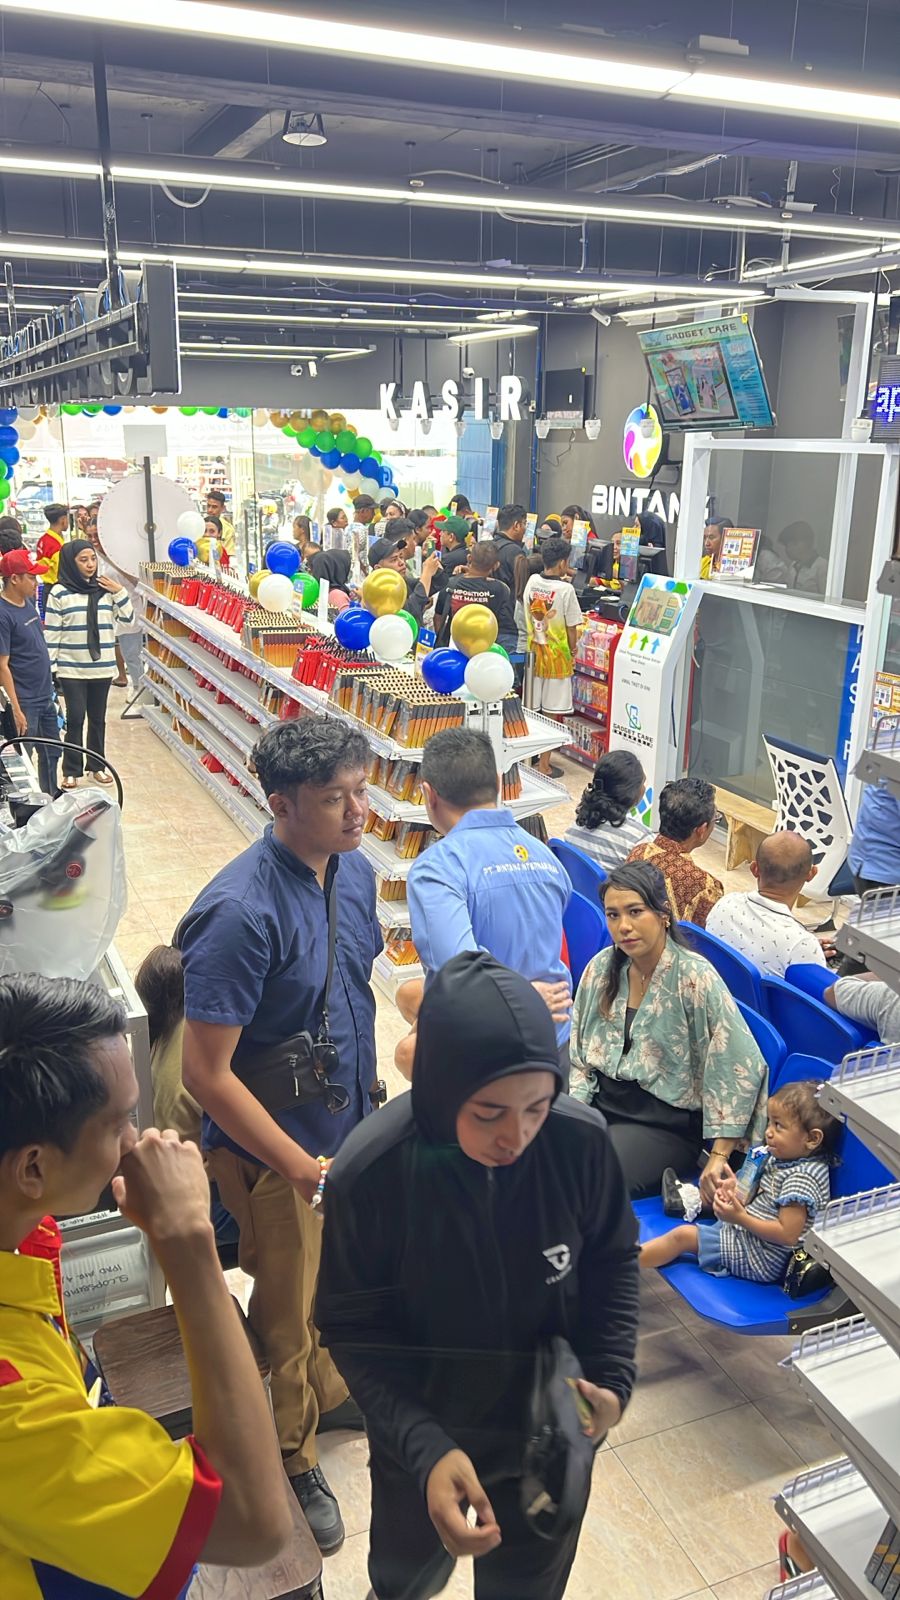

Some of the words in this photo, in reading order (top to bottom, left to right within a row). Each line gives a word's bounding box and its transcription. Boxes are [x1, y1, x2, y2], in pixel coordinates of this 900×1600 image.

[666, 329, 704, 341] GADGET
[708, 323, 737, 335] CARE
[380, 375, 522, 420] KASIR
[591, 484, 710, 528] BINTAN
[637, 732, 653, 743] CARE
